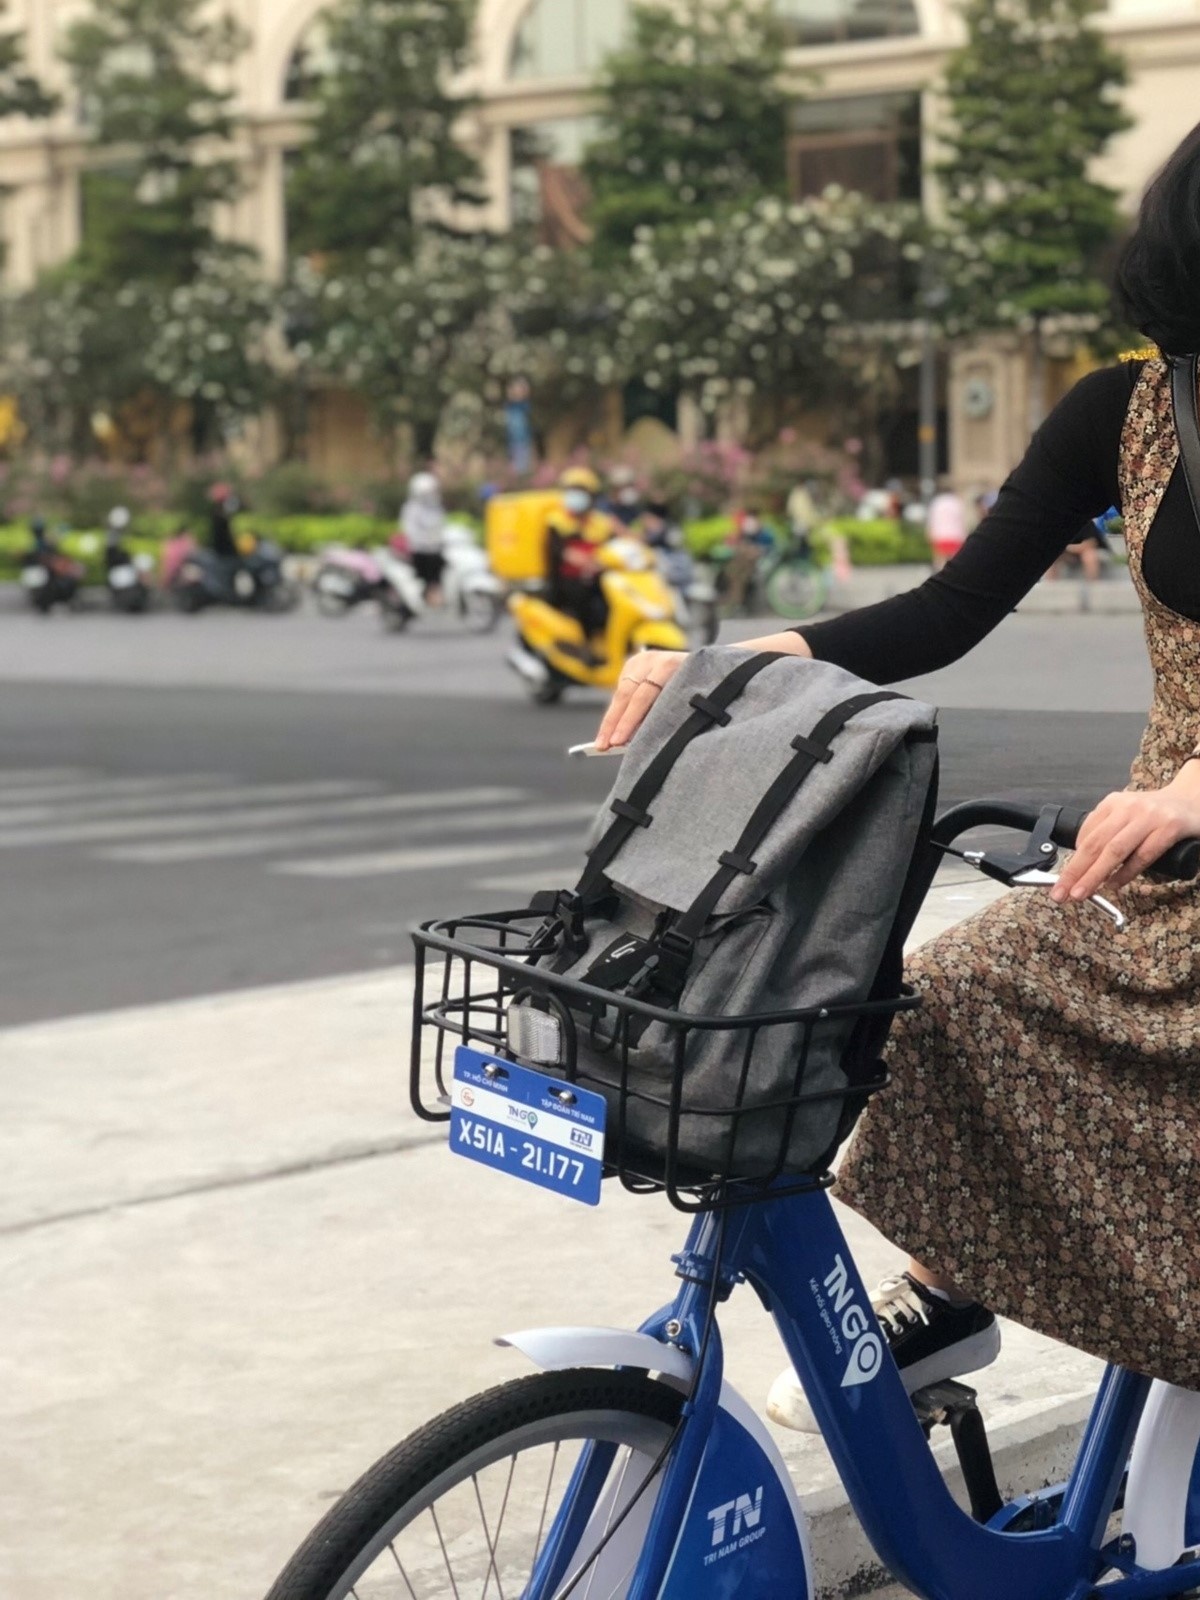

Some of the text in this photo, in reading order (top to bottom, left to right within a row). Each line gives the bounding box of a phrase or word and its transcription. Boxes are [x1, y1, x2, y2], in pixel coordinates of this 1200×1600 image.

[459, 1118, 505, 1157] X51A
[521, 1142, 585, 1185] 21.177
[823, 1253, 883, 1387] TNGO
[703, 1526, 766, 1567] TRI NAM GROUP
[707, 1485, 763, 1546] TN
